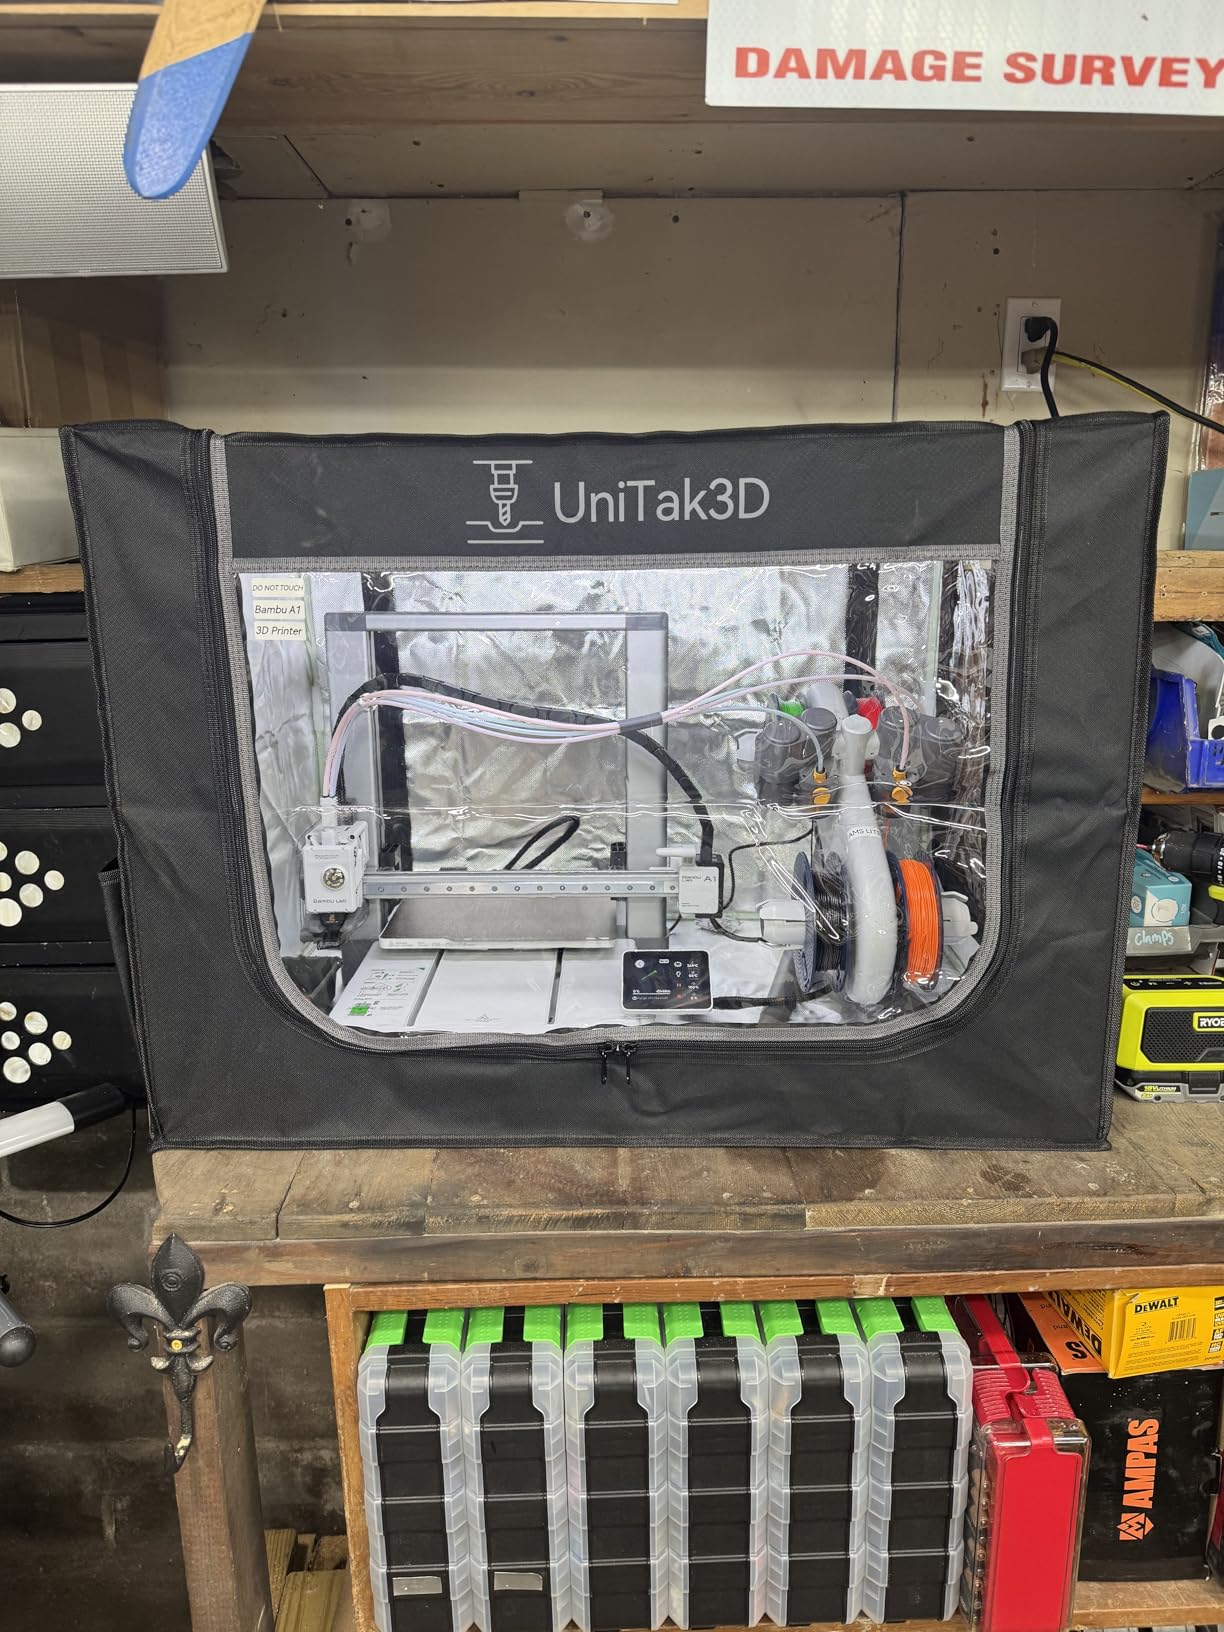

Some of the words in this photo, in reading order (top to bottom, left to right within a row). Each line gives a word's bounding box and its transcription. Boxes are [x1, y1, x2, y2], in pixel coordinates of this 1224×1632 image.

[734, 46, 983, 83] DAMAGE
[1003, 52, 1224, 90] SURVEY
[554, 477, 770, 523] UniTak3D
[254, 604, 287, 614] Bambu
[289, 605, 301, 614] A1
[256, 626, 269, 635] 3D
[271, 626, 303, 635] Printer
[849, 829, 865, 839] AMS
[1122, 1418, 1160, 1509] AMPAS
